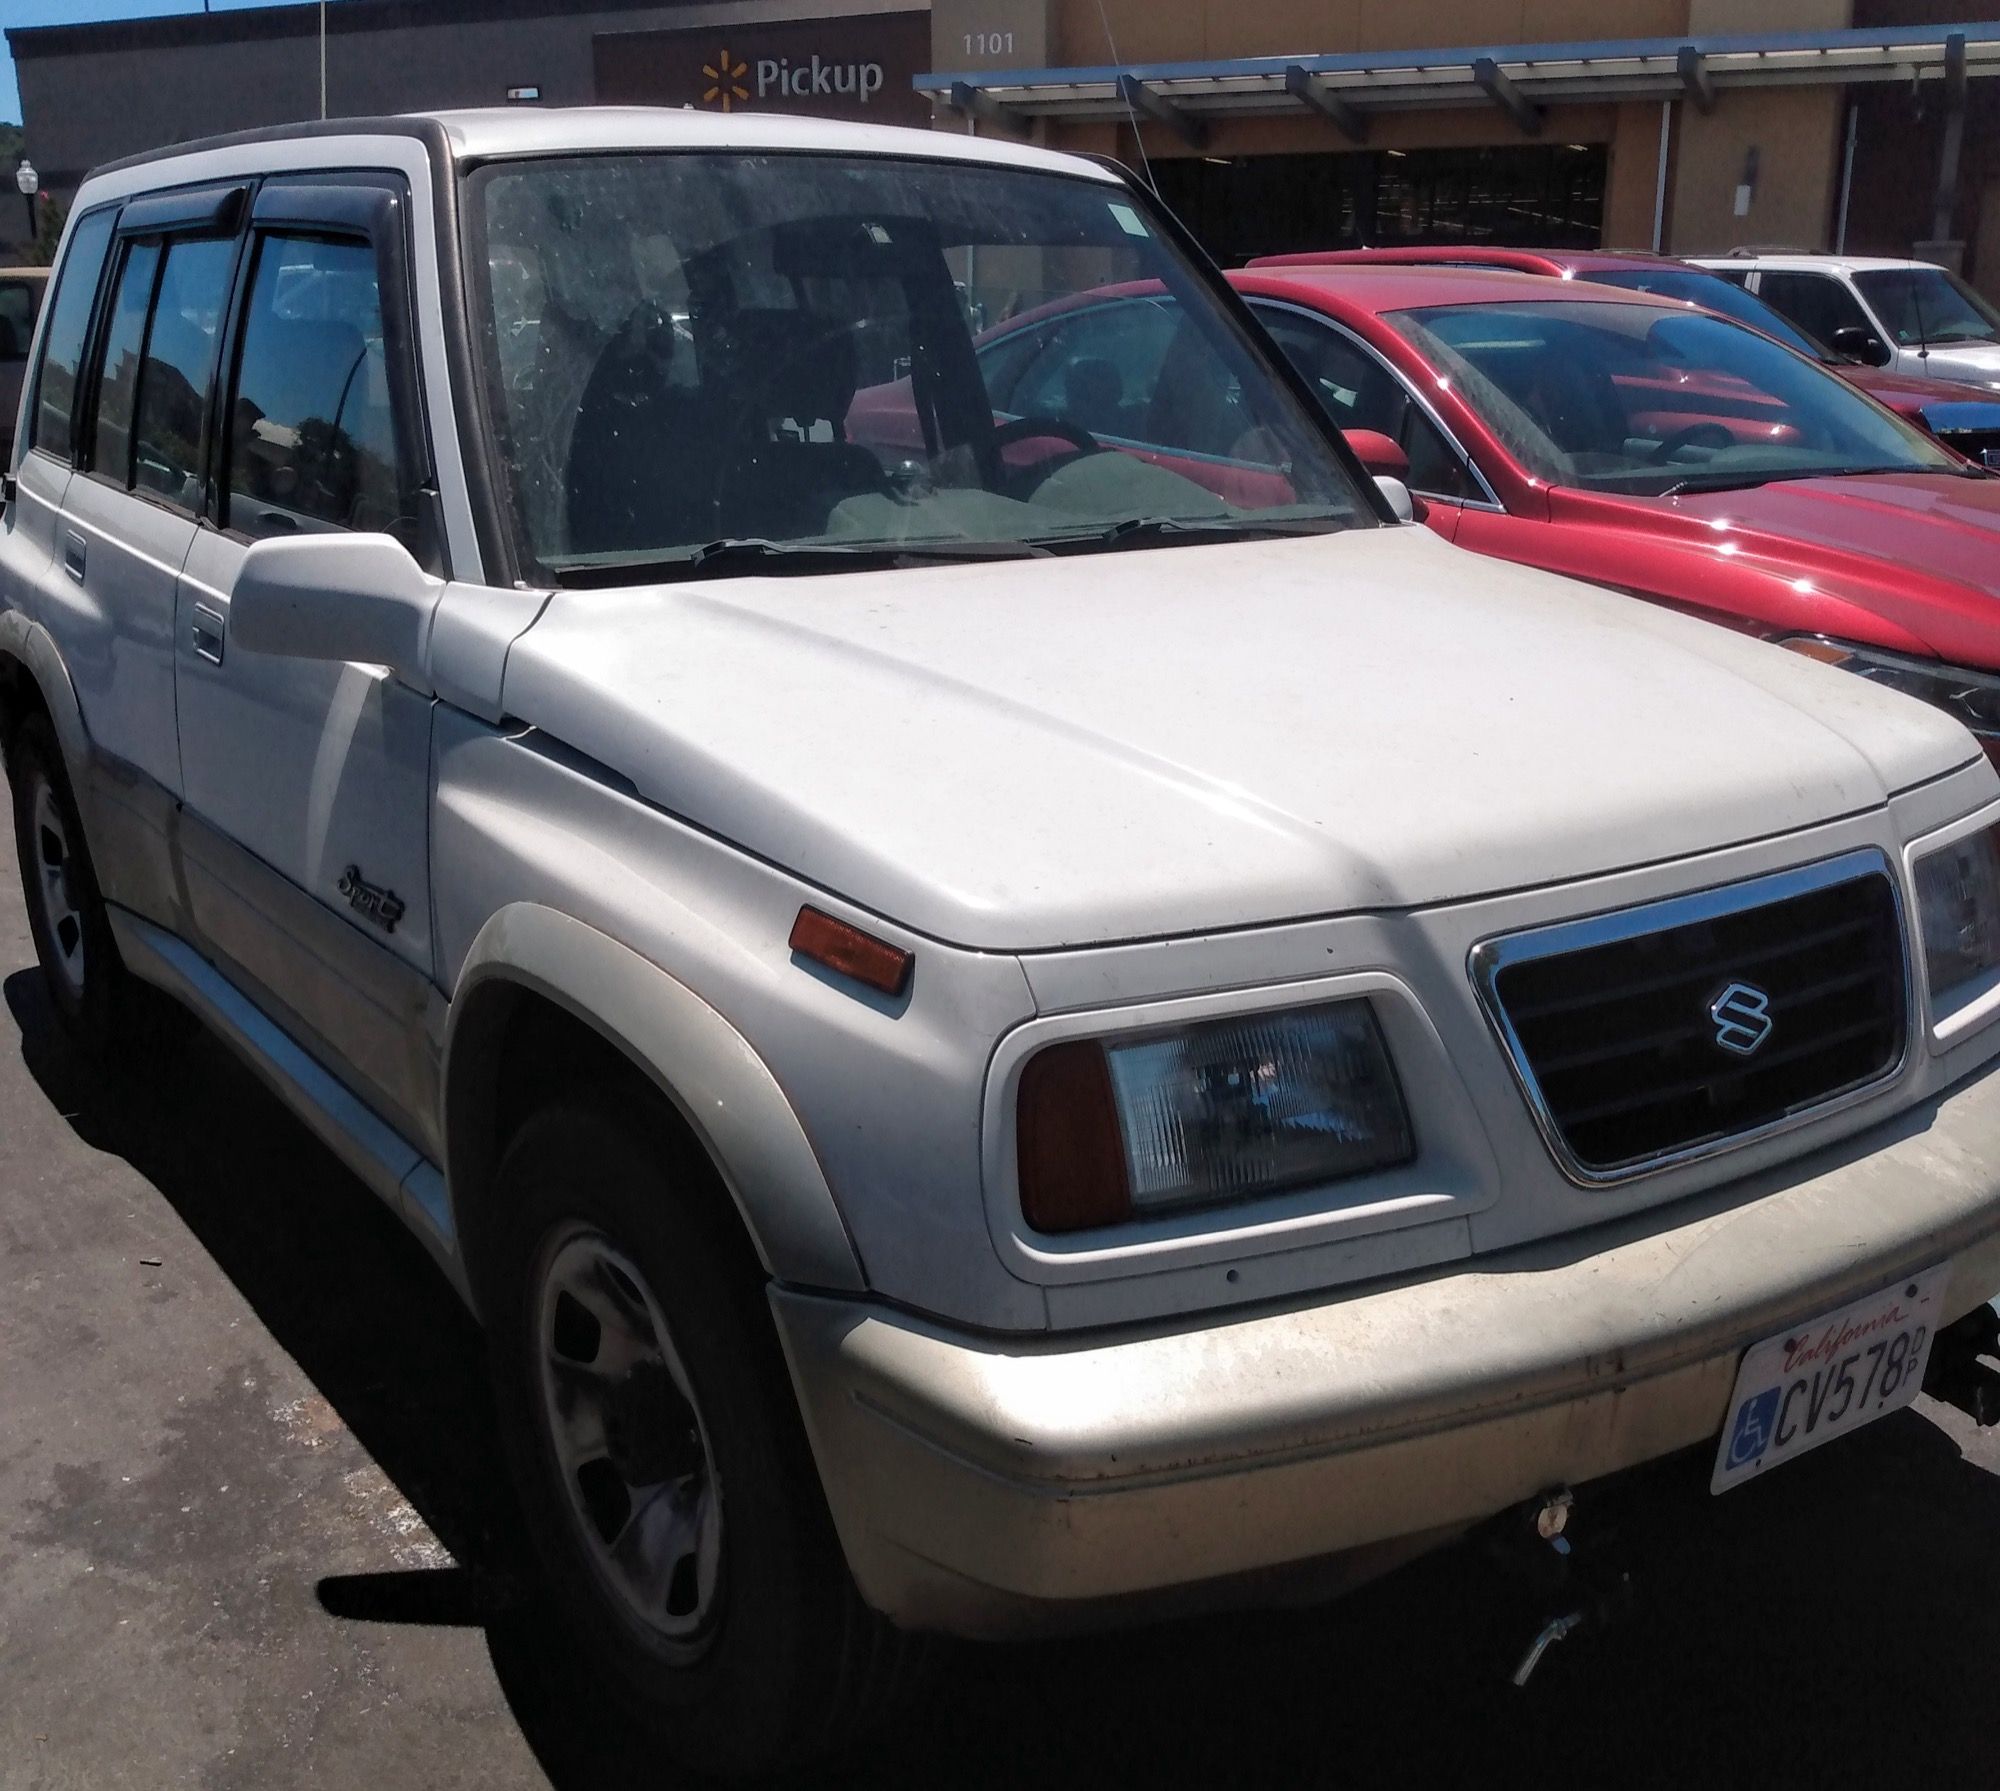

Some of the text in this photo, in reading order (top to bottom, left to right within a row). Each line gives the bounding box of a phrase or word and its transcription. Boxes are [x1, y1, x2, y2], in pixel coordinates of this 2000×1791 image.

[963, 32, 1014, 55] 1101
[756, 54, 884, 103] Pickup
[337, 864, 405, 933] Sport
[1783, 1304, 1909, 1373] California
